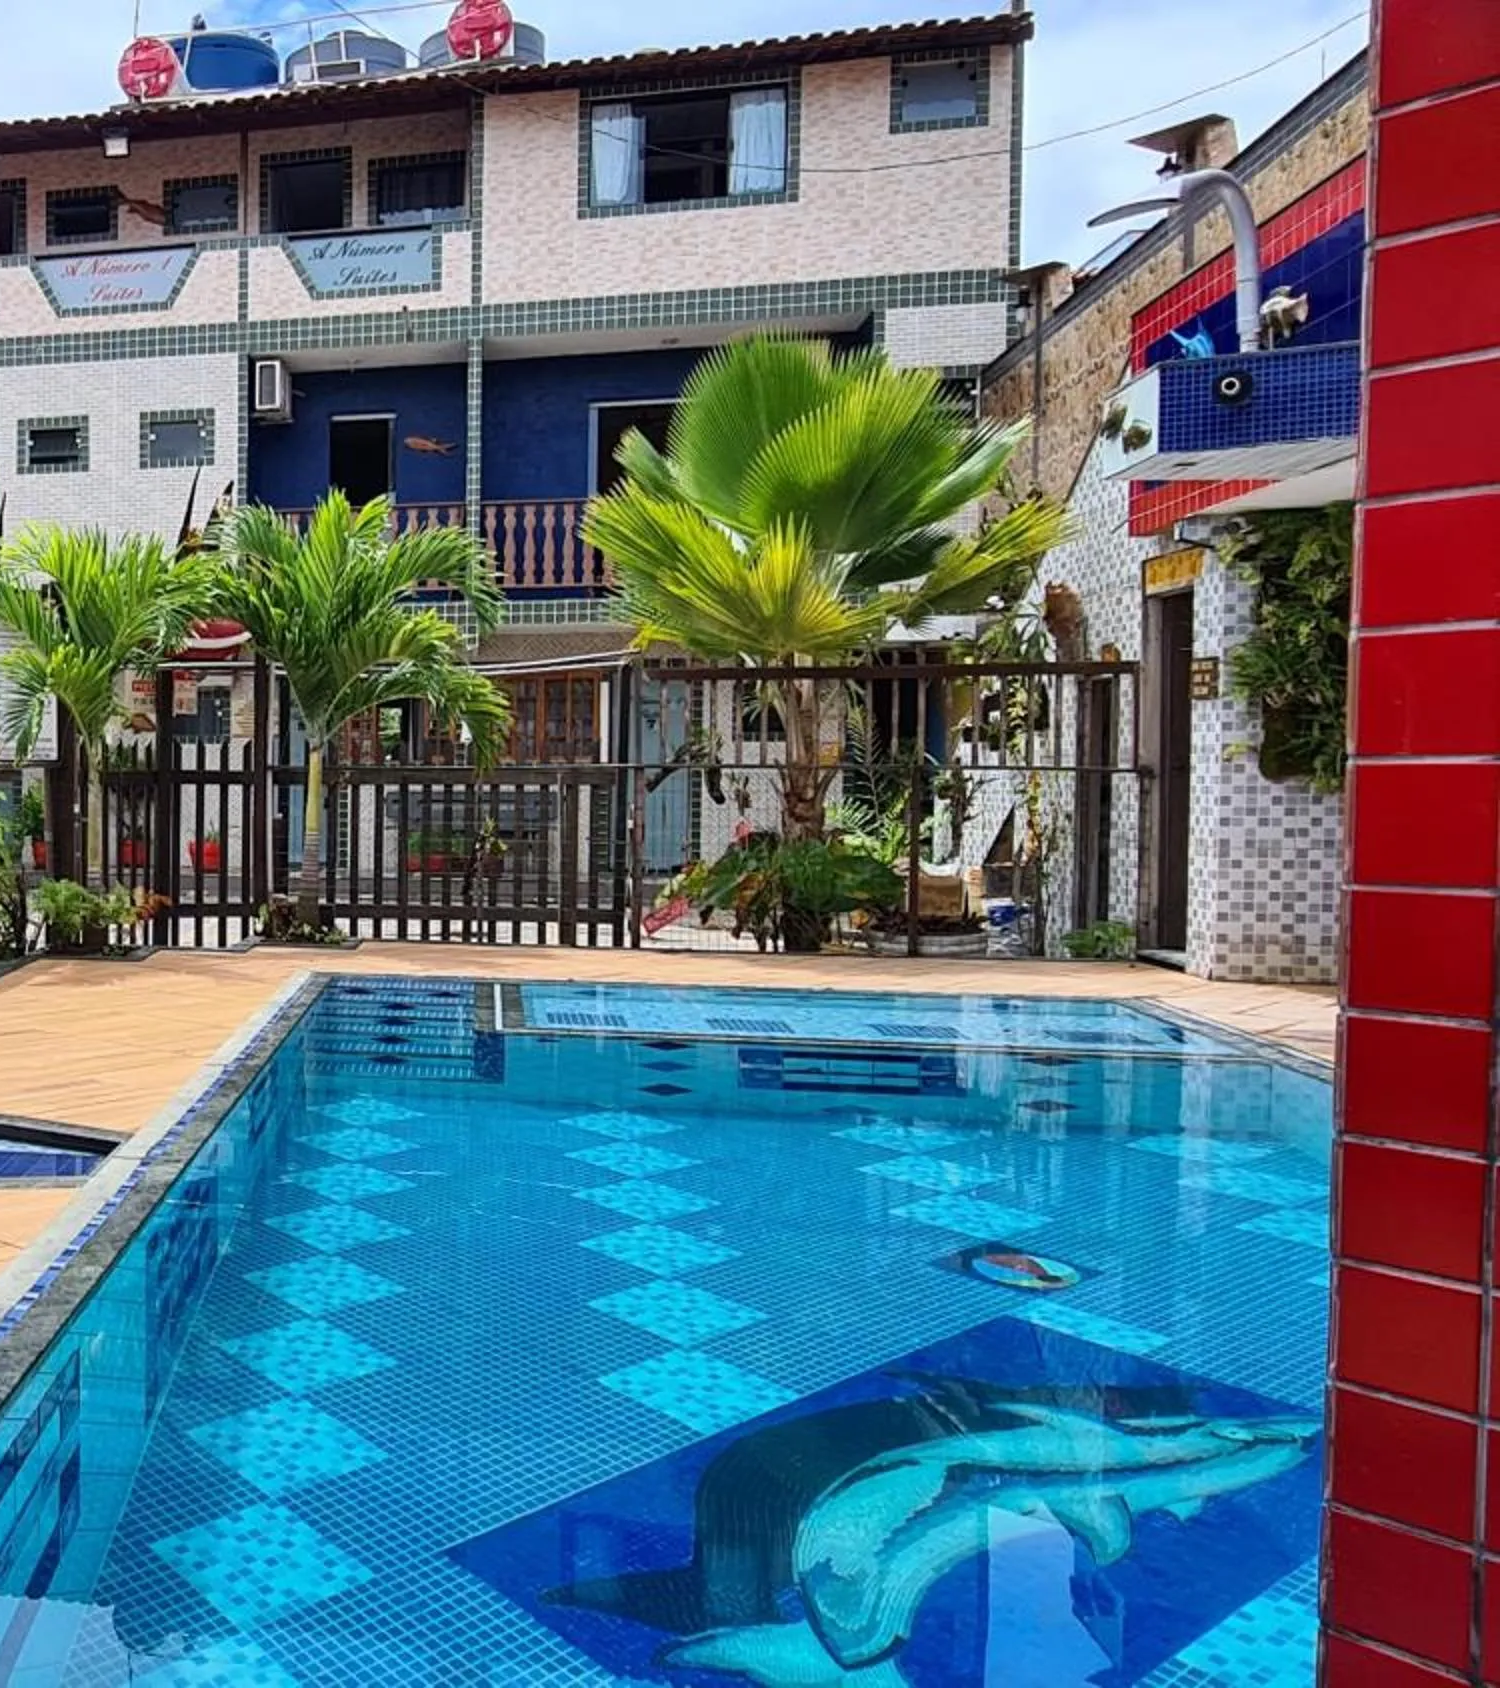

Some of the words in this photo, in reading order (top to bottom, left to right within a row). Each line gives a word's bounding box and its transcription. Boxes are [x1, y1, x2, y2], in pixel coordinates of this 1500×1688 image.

[308, 240, 332, 261] A
[416, 238, 429, 253] 1
[162, 255, 173, 270] 1
